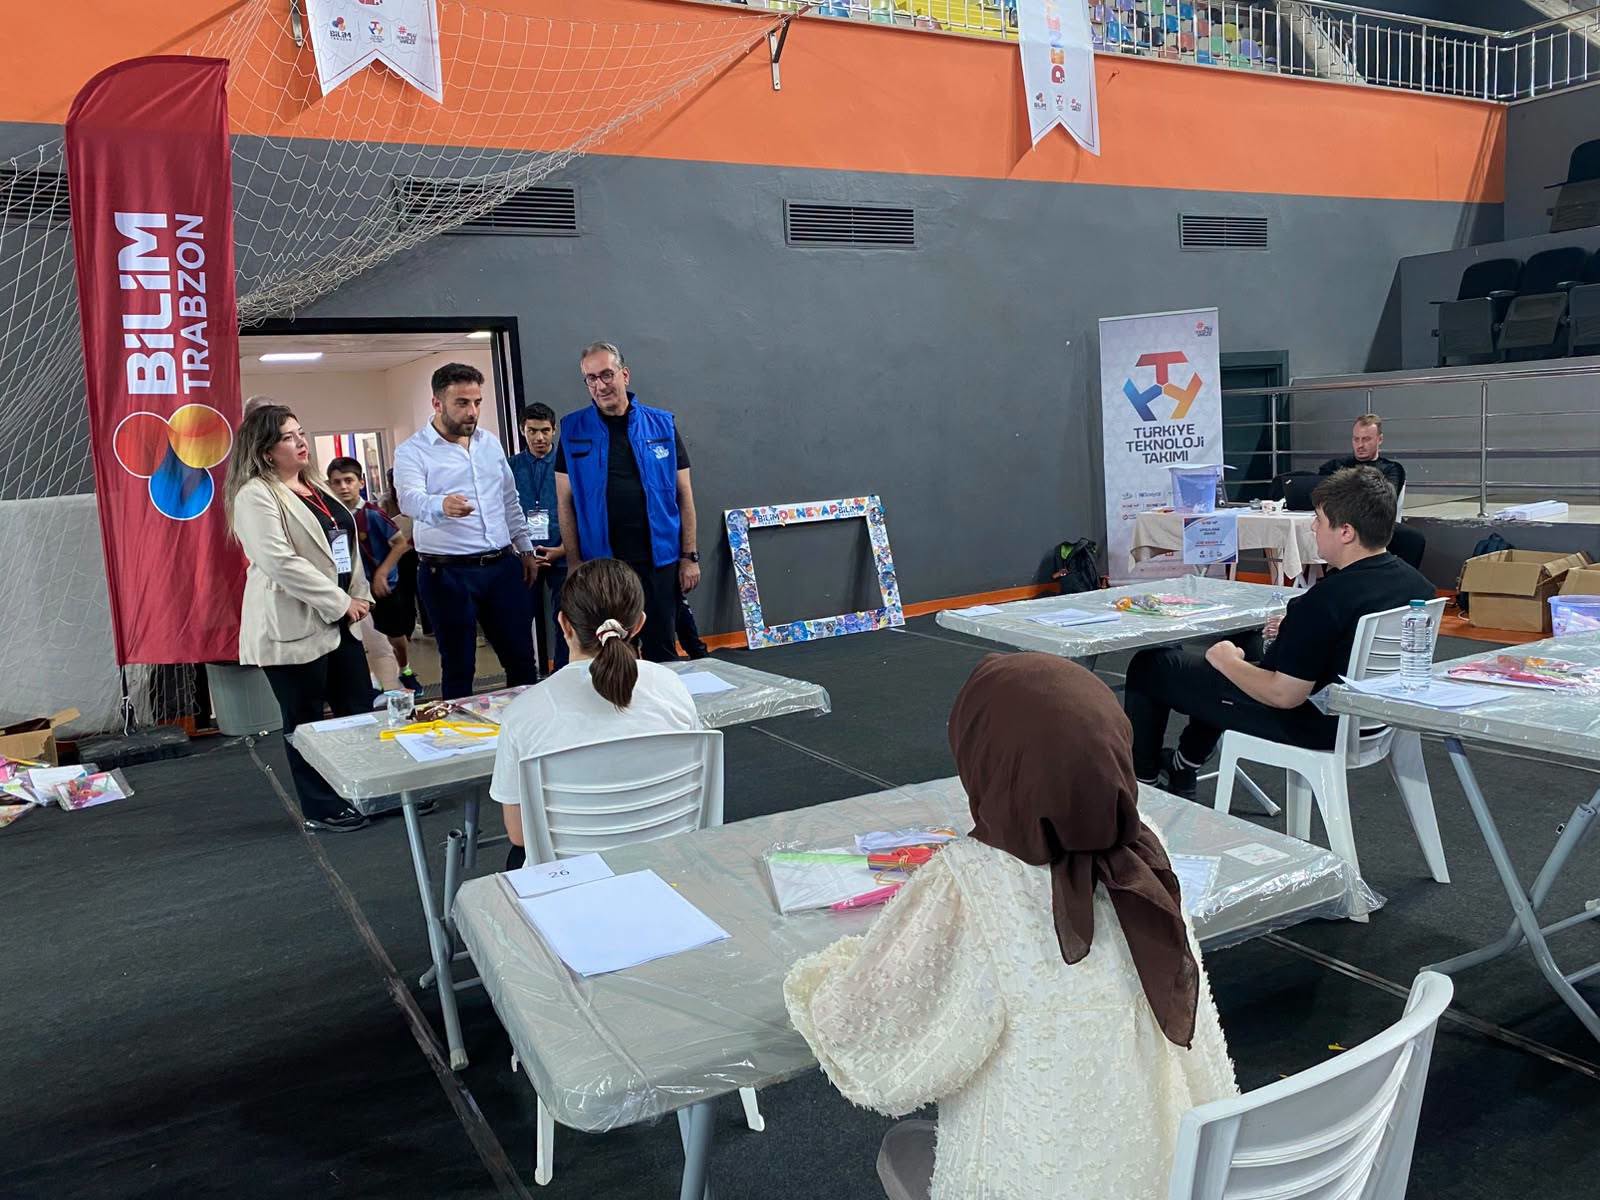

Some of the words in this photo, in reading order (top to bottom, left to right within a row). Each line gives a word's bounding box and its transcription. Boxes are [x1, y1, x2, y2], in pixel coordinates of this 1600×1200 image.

[174, 213, 211, 395] TRABZON
[1142, 450, 1189, 464] TAKIMI
[779, 504, 838, 520] DENEYAP
